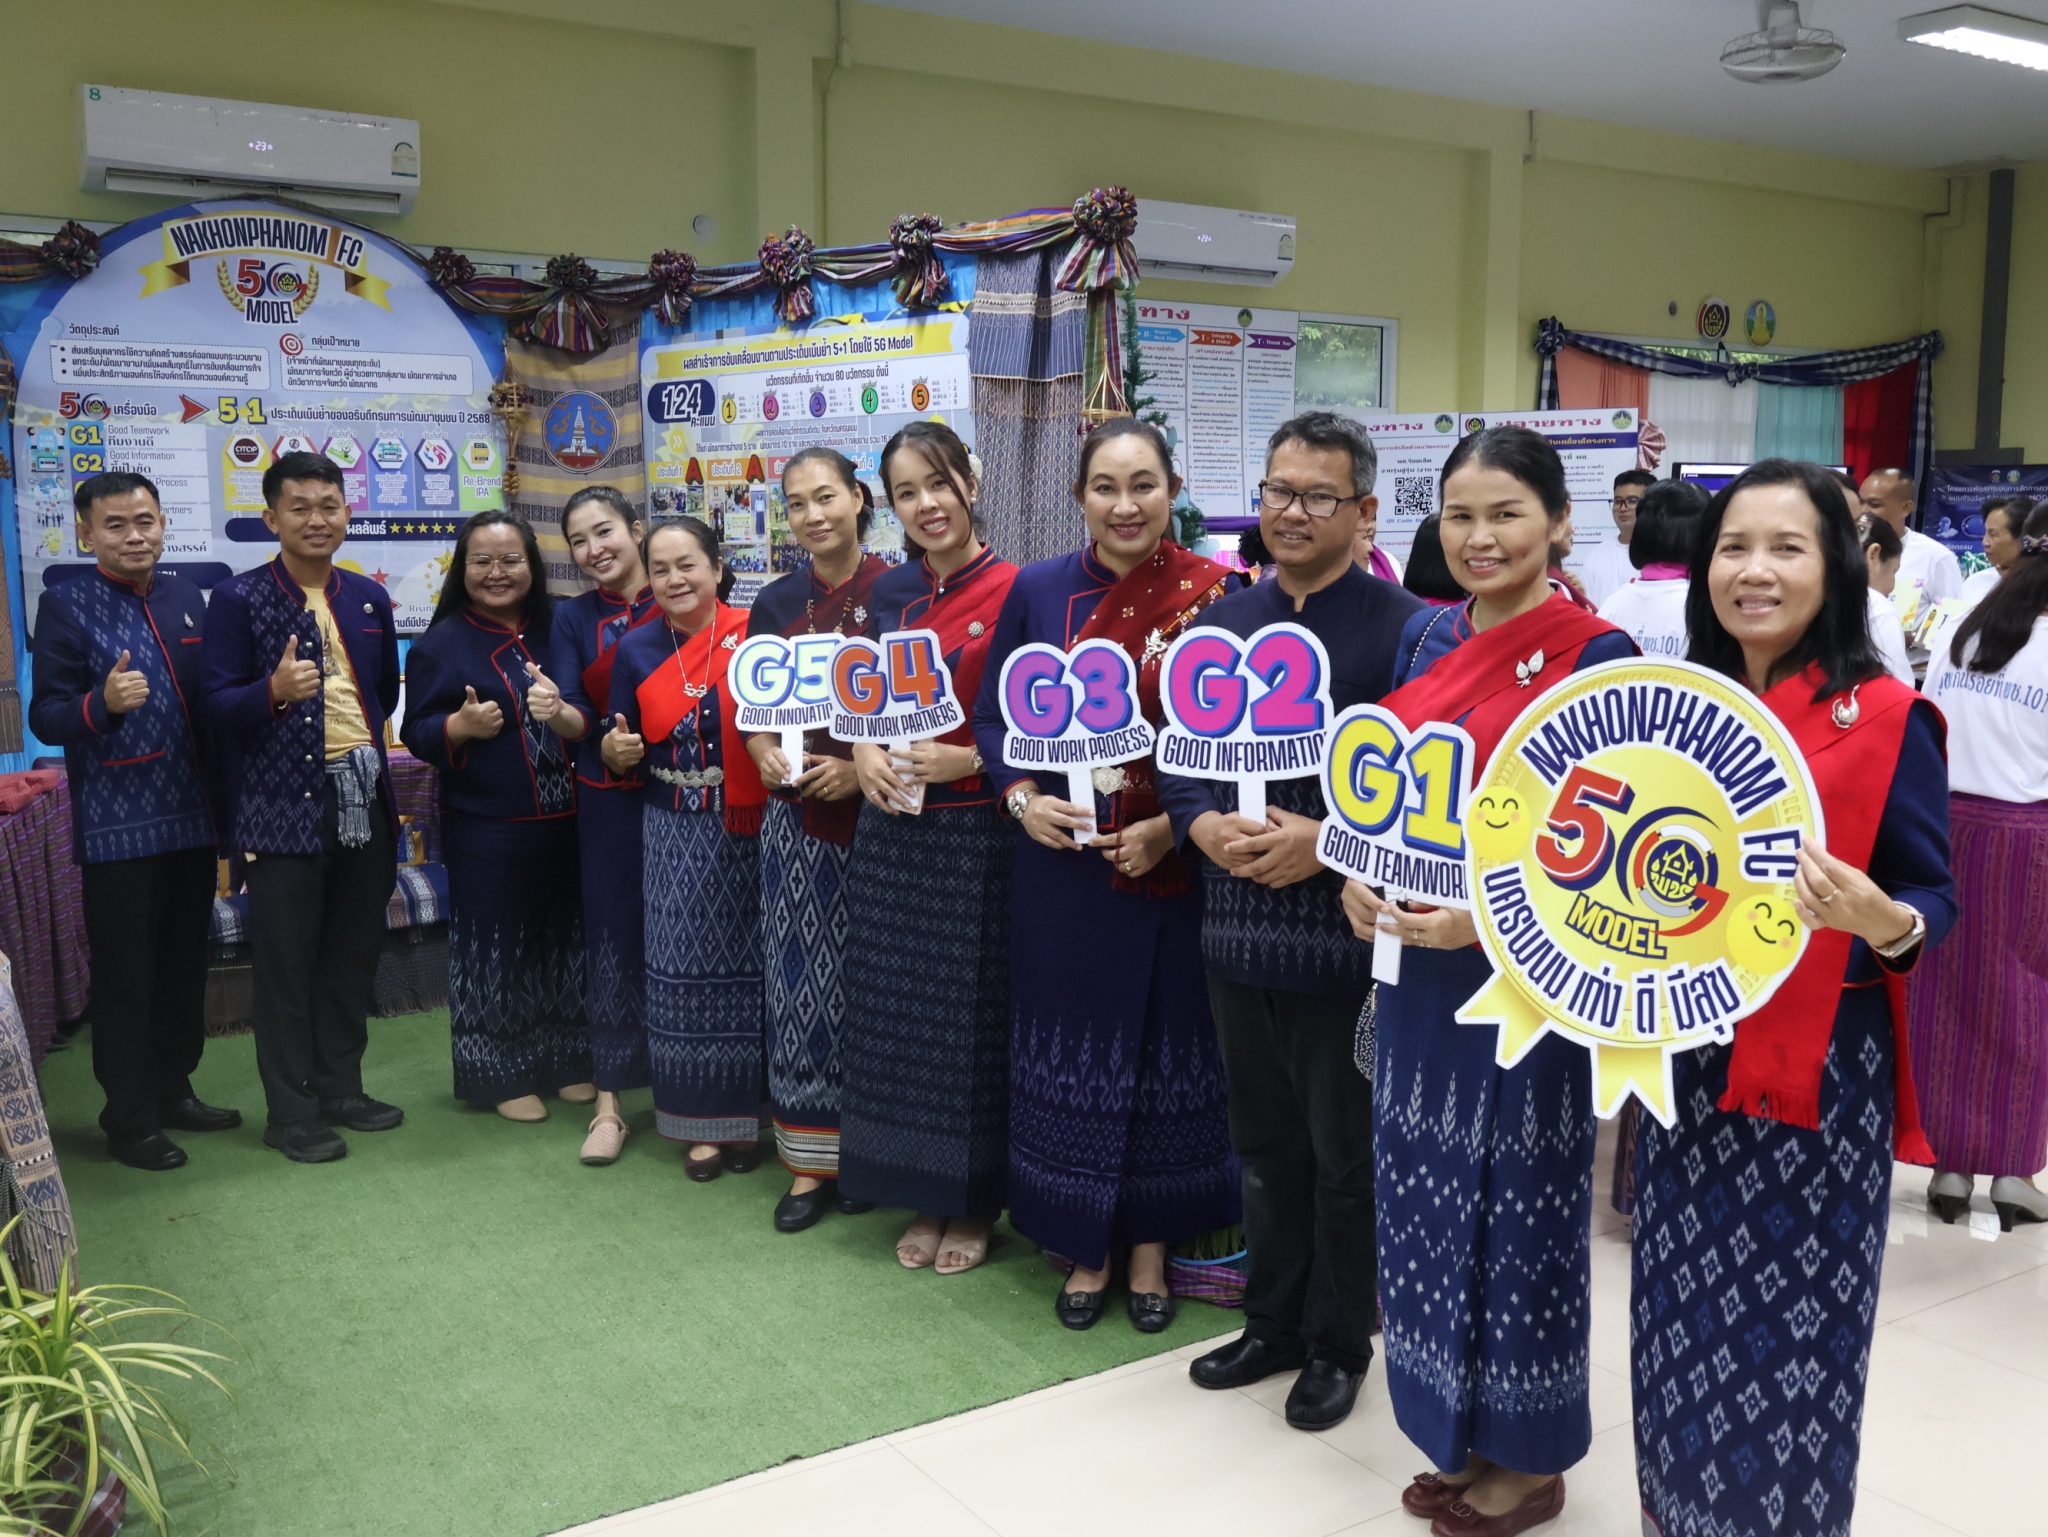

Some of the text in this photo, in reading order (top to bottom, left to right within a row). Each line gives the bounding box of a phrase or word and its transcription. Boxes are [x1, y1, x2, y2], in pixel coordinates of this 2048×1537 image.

[89, 87, 101, 101] 8
[255, 141, 268, 151] 23
[170, 217, 364, 267] NAKHONPHANOM FC
[246, 299, 298, 324] MODEL
[1138, 306, 1190, 320] ทาง
[69, 323, 120, 338] วัตถุประสงค์
[311, 335, 360, 349] กลุ่มเป้าหมาย
[683, 335, 913, 370] ผลสำเร็จการขับเคลื่อนงานตามประเด็นเน้นย้ำ 5+1 โดยใช้ 5G Model
[286, 355, 381, 369] (เจ้าหน้าที่พัฒนาชุมชนทุกระดับ)
[287, 367, 342, 377] พัฒนาการจังหวัด
[765, 362, 889, 387] นวัตกรรมที่เกิดขึ้น จำนวน 80 นวัตกรรม ดังนี้
[349, 379, 378, 389] พัฒนากร
[113, 399, 157, 416] เครื่องมือ
[662, 383, 701, 420] 124
[271, 405, 491, 426] ประเด็นเน้นย้ำของอธิบดีกรมการพัฒนาชุมชน ปี 2568
[690, 415, 716, 428] คะแนน
[70, 424, 103, 446] G1
[108, 424, 170, 435] Good Teamwork
[1367, 422, 1424, 432] งทาง
[108, 435, 154, 447] ทีมงานดี
[235, 445, 257, 453] OTOP
[781, 440, 788, 449] 10
[881, 435, 887, 443] 16
[72, 453, 104, 473] G2
[109, 450, 175, 460] Good Information
[657, 461, 679, 478] ประเด็นที่
[712, 460, 741, 477] ประเด็นที่ 2
[868, 459, 874, 470] 4
[155, 477, 188, 487] Process
[463, 476, 501, 486] Re-Brand
[476, 487, 490, 497] IPA
[735, 639, 830, 708] G5
[831, 636, 946, 716] G4
[1005, 646, 1134, 739] G3
[1168, 630, 1324, 739] G2
[741, 702, 833, 726] GOOD INNOVATIO
[835, 701, 958, 738] GOOD WORK PARTNERS
[1009, 724, 1151, 764] GOOD WORK PROCESS
[1163, 731, 1328, 773] GOOD INFORMATIO
[1327, 714, 1466, 861] G1
[1521, 686, 1801, 879] NAKHONPHANOM FC
[1323, 824, 1469, 900] GOOD TEAMWOR
[1565, 892, 1669, 959] MODEL
[1484, 866, 1741, 1036] นครพนม เก่ง ดี มีสุข
